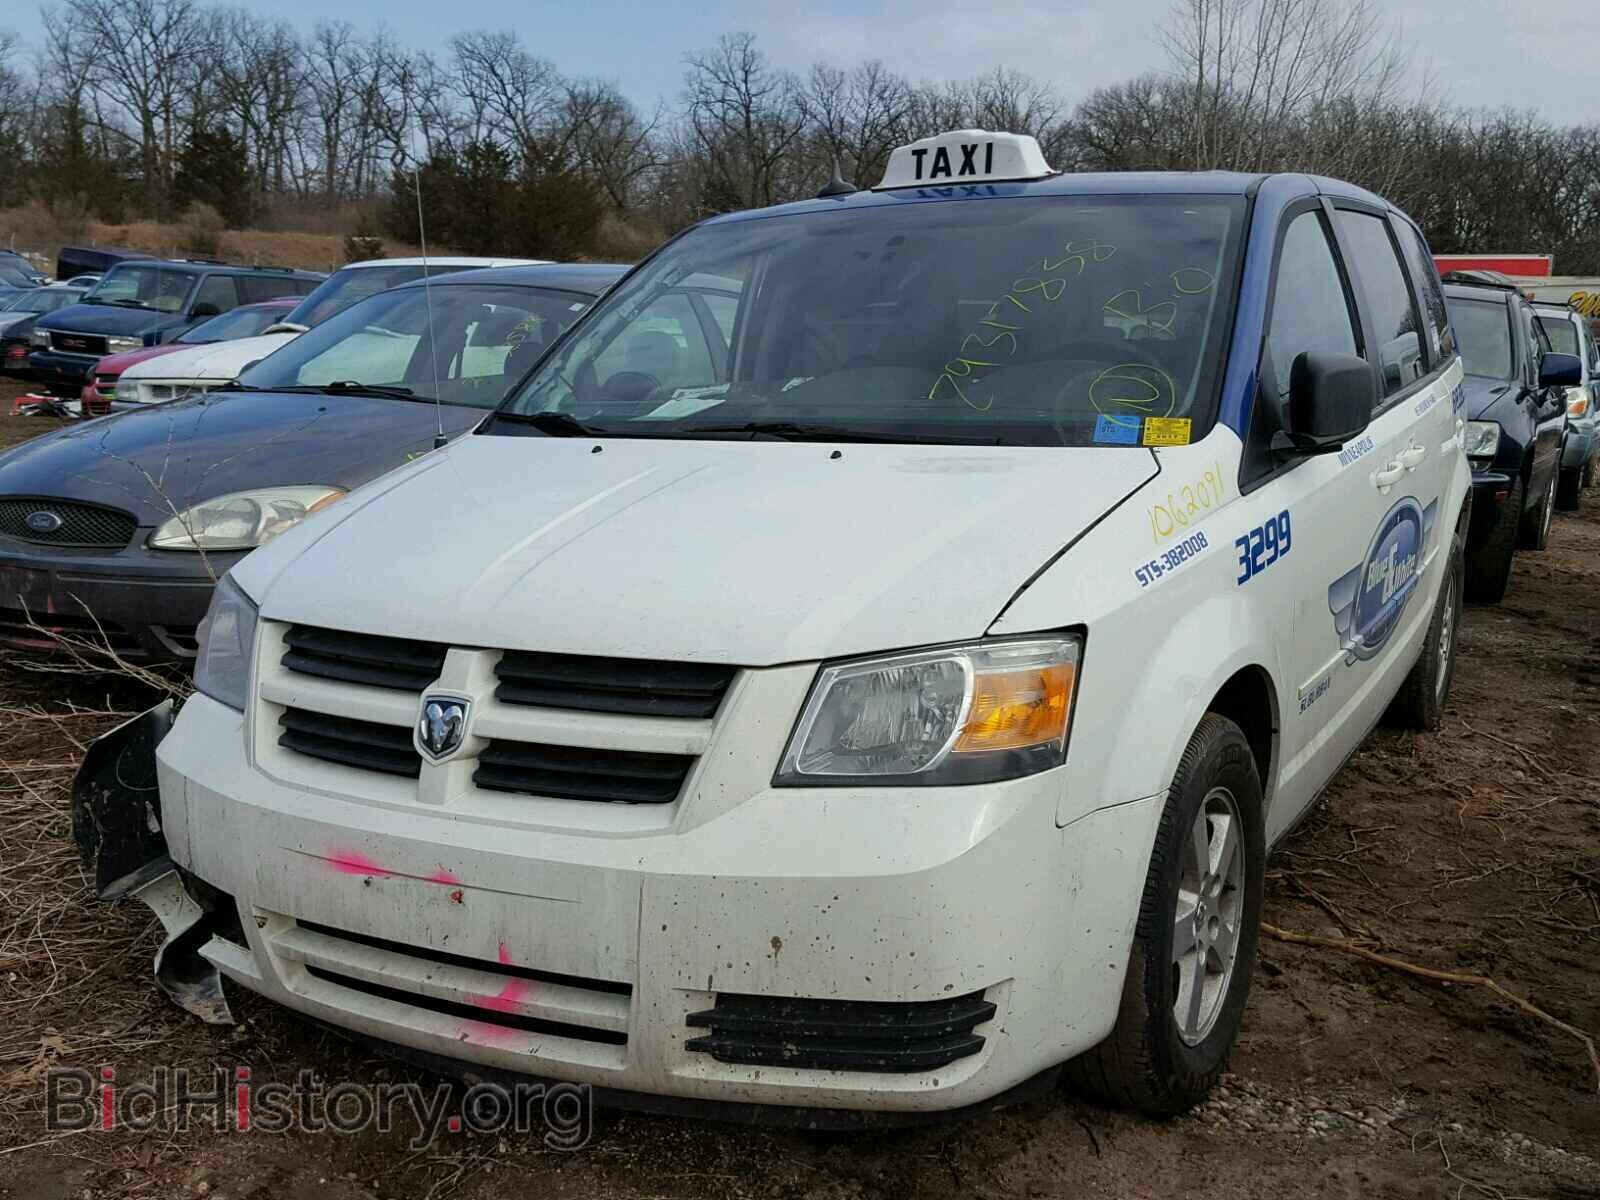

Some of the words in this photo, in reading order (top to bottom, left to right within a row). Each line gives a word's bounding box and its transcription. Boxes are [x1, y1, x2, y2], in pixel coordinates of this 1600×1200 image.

[911, 142, 993, 180] TAXI
[1146, 461, 1224, 544] 1062091
[1134, 531, 1209, 588] STS-382008
[1235, 509, 1292, 586] 3299
